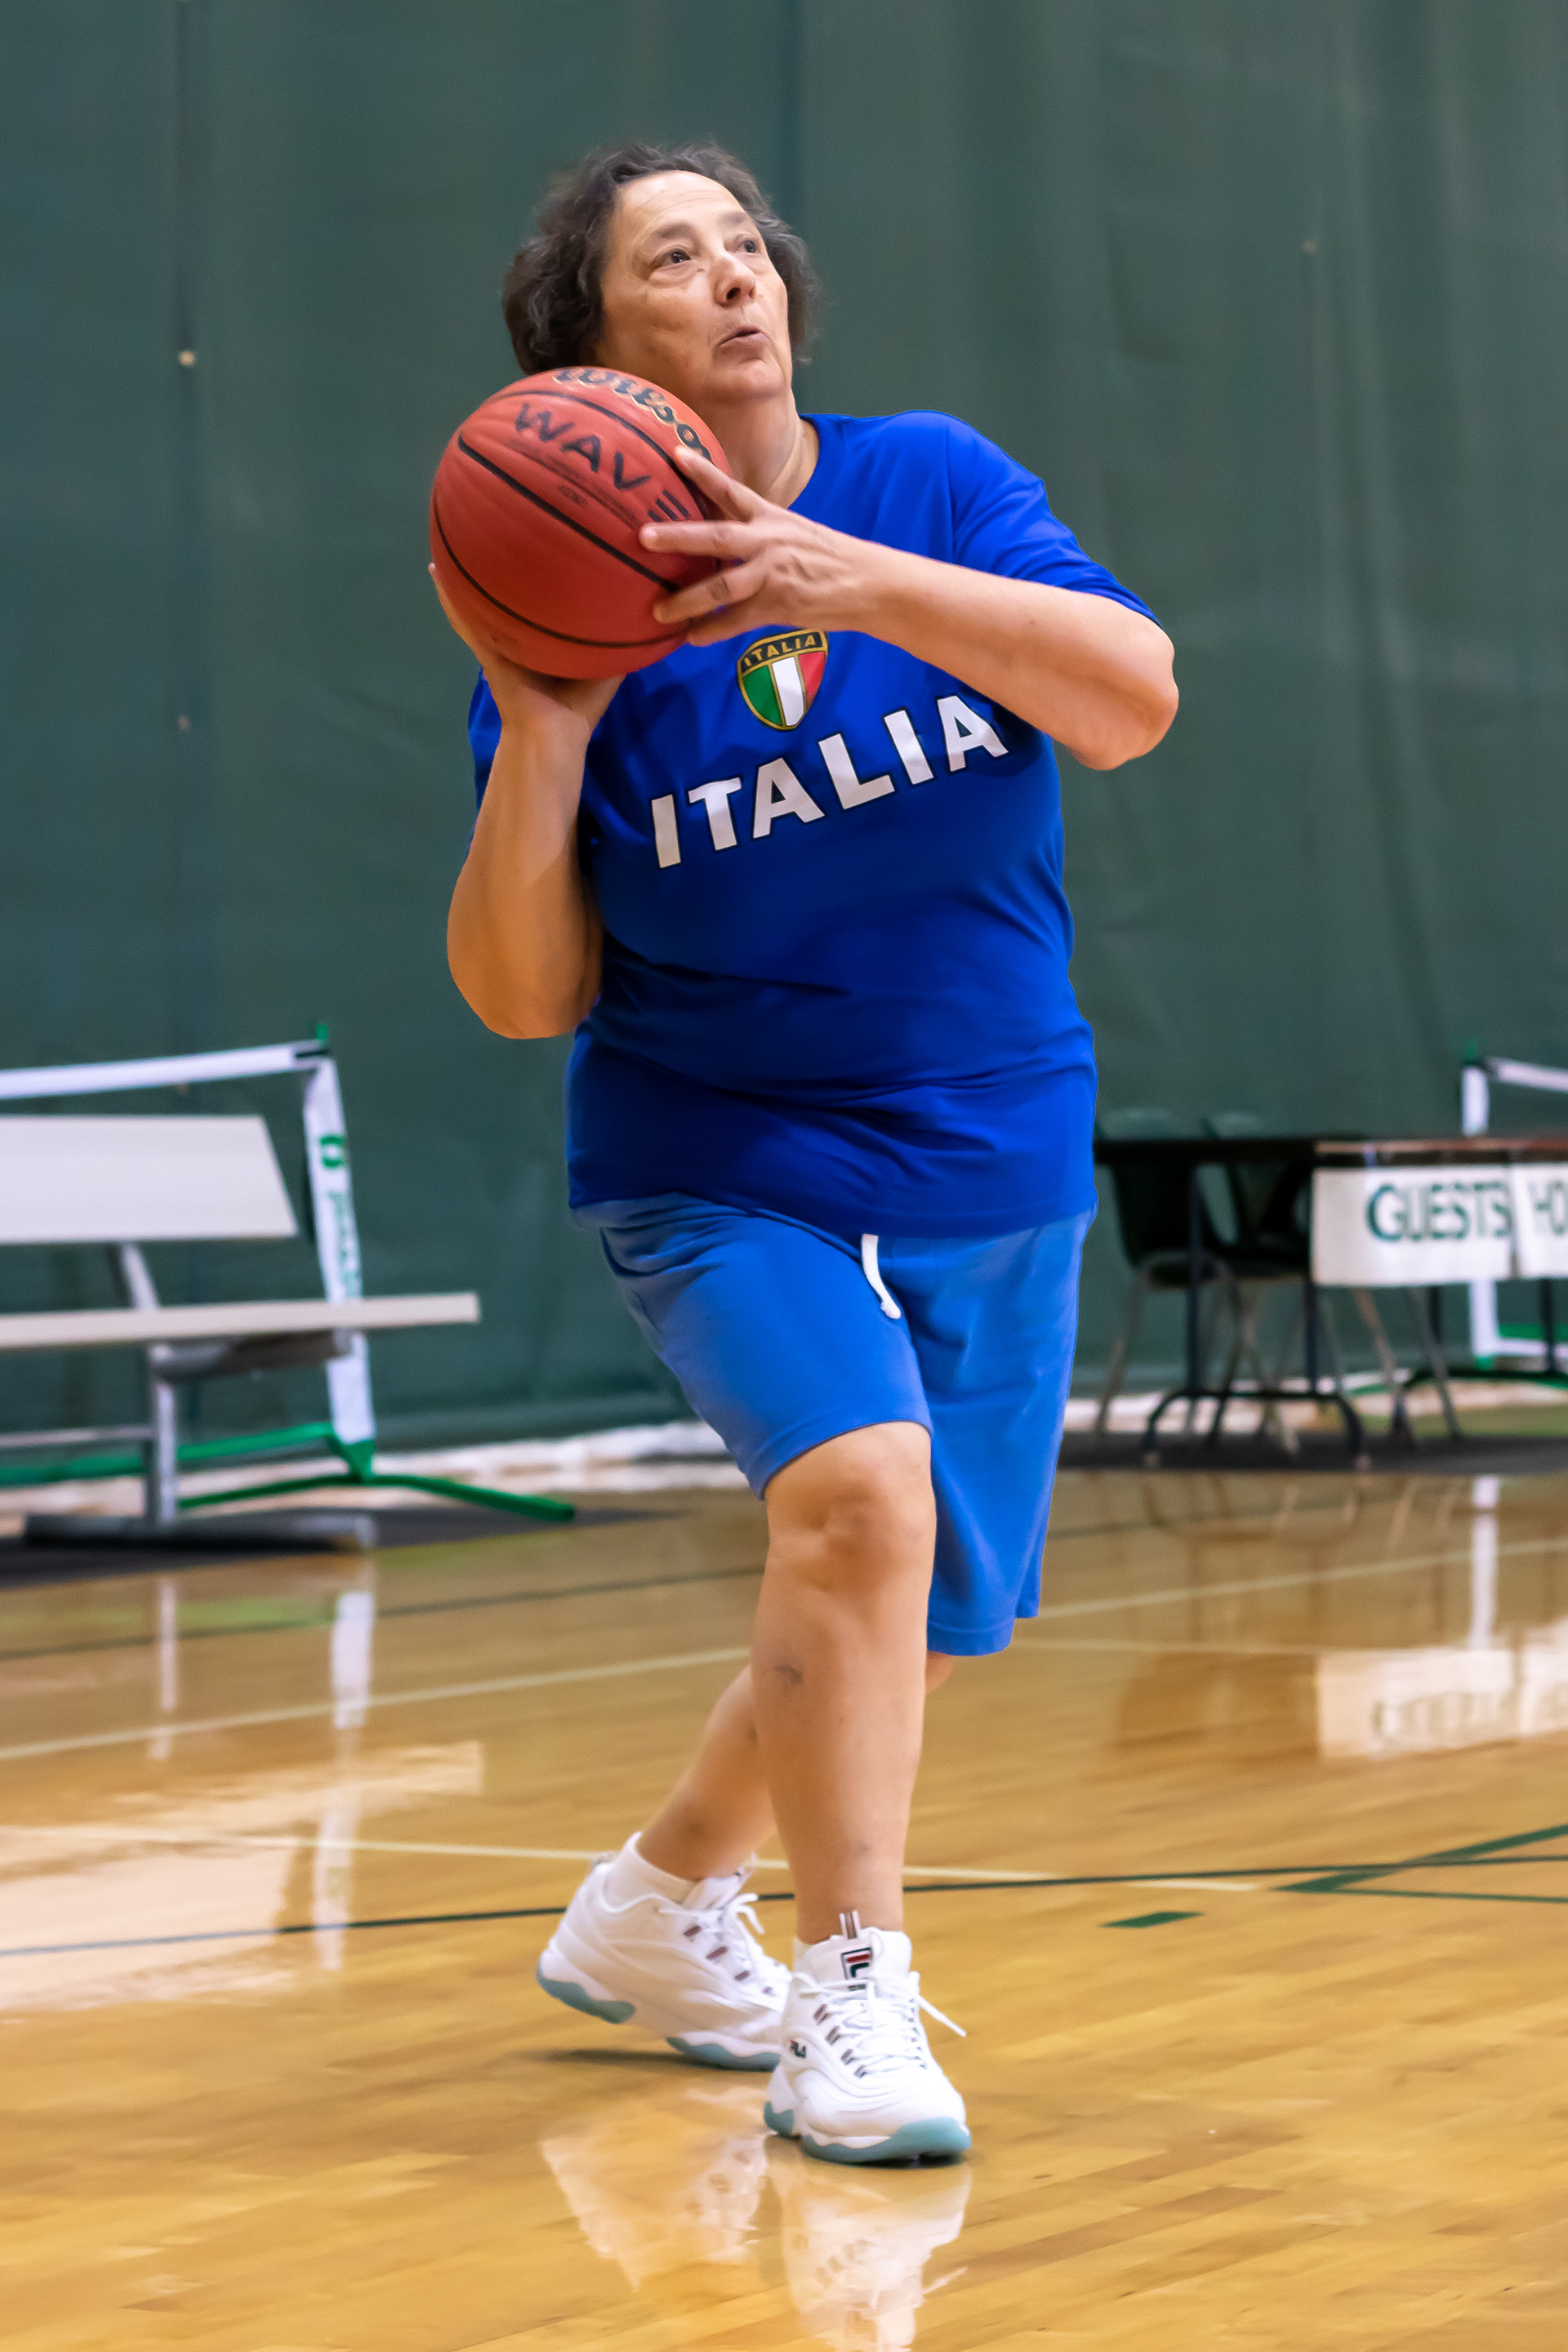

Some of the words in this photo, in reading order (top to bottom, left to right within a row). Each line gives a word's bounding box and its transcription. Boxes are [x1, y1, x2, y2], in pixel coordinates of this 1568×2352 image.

[744, 635, 816, 666] ITALIA
[652, 695, 1009, 869] ITALIA
[1366, 1182, 1513, 1242] GUESTS
